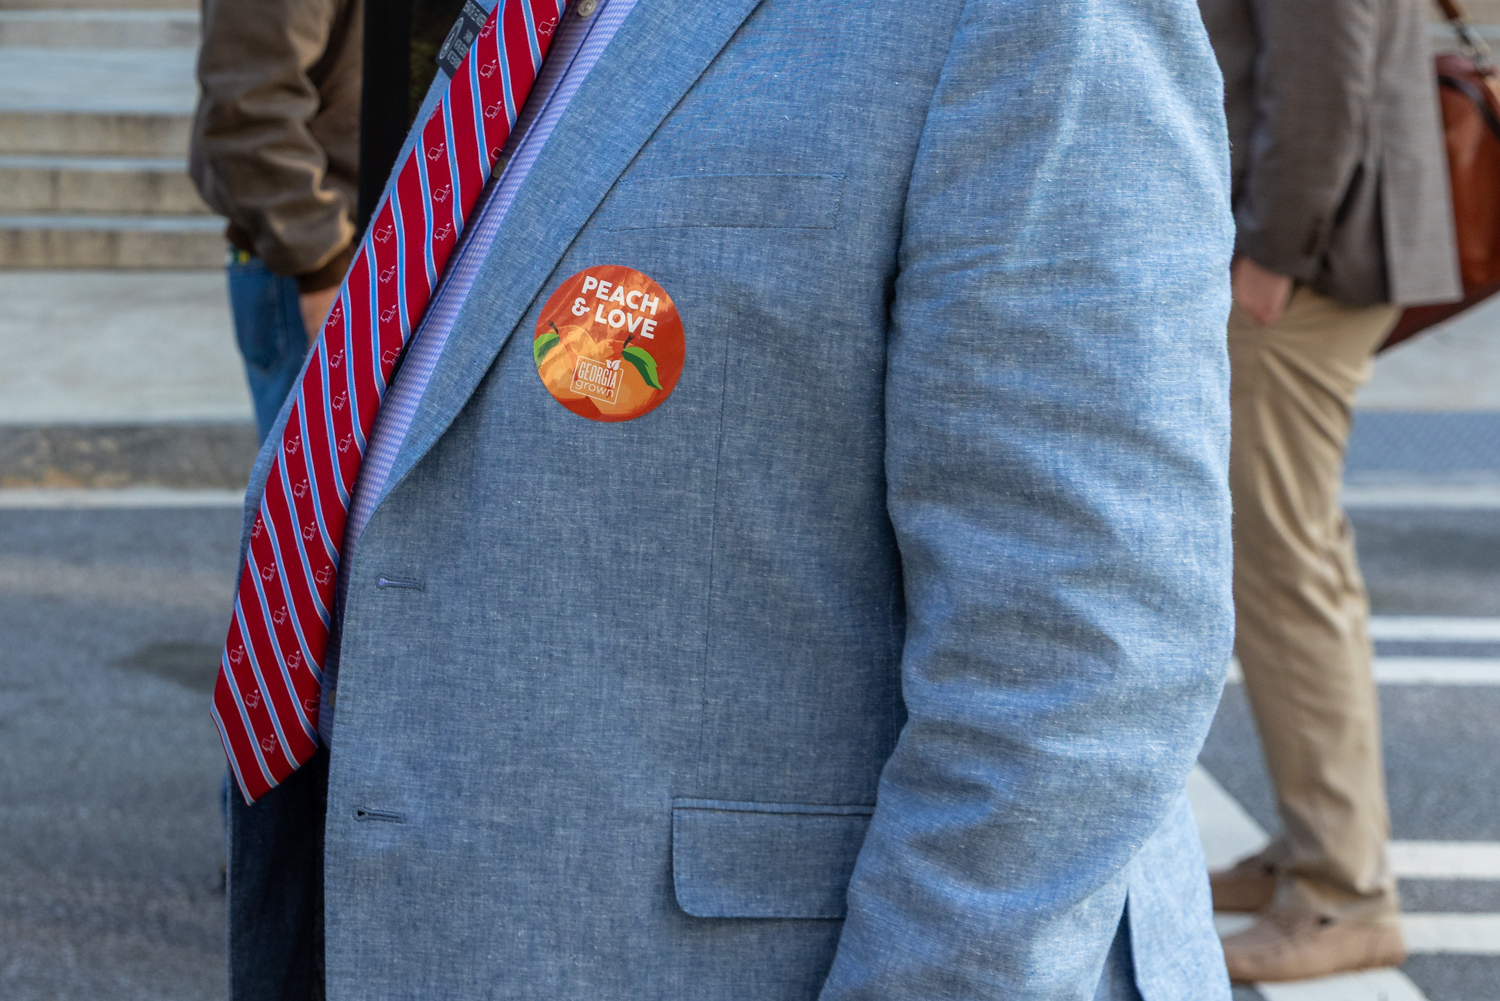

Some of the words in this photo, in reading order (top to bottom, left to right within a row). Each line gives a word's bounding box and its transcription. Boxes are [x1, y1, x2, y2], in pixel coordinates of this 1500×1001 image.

[581, 275, 660, 316] PEACH
[571, 297, 591, 317] &
[594, 303, 658, 340] LOVE
[575, 379, 614, 398] grown
[578, 361, 618, 389] GEORGIA
